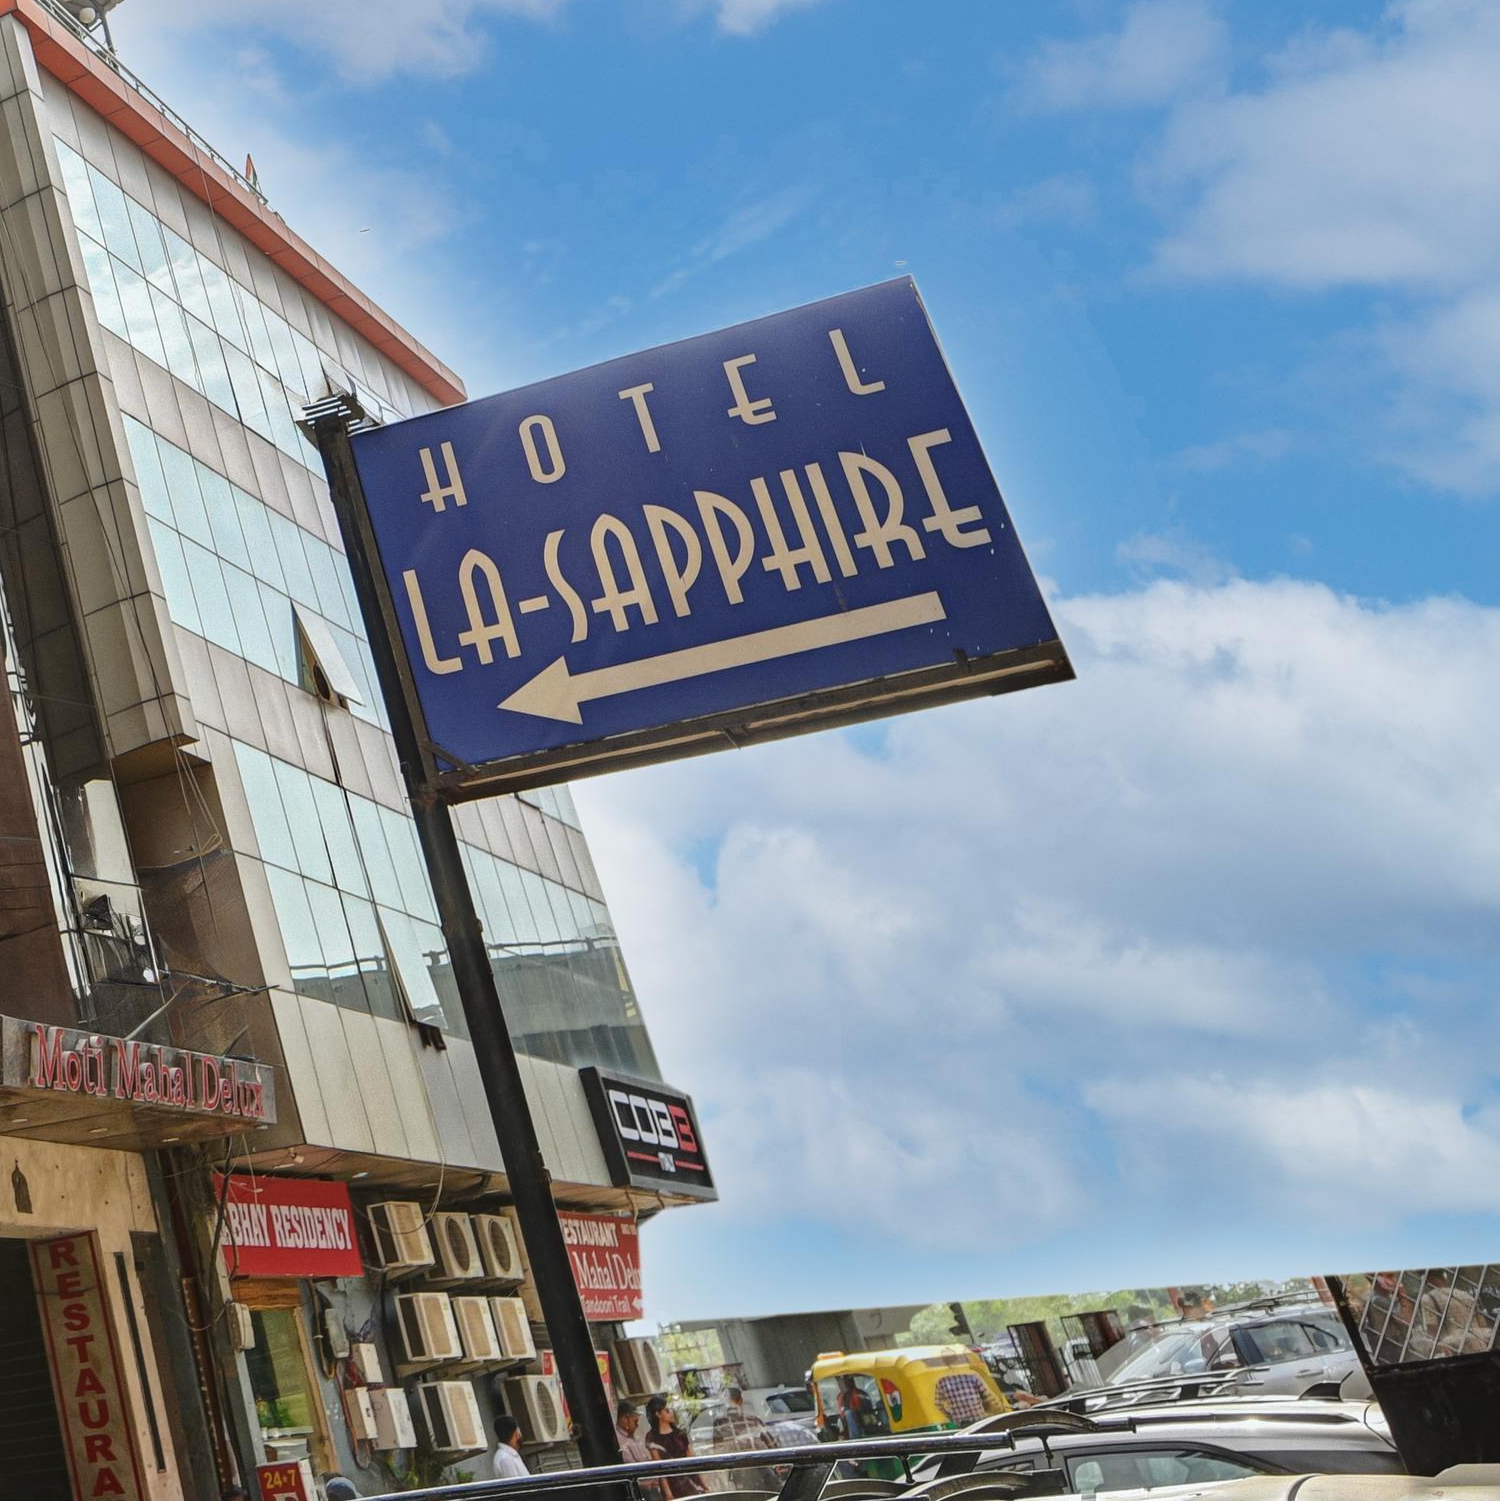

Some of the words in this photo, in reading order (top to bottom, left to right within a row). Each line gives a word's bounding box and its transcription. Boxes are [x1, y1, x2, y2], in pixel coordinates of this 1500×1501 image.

[419, 329, 886, 512] HOTEL
[402, 428, 992, 675] LA-SAPPHIRE
[33, 1025, 108, 1097] Moti
[114, 1039, 196, 1109] Mahal
[201, 1055, 265, 1118] Delux
[608, 1089, 698, 1153] COBB
[269, 1204, 353, 1250] RESIDENCY
[572, 1250, 618, 1290] Mahal
[49, 1241, 125, 1497] RESTAURA
